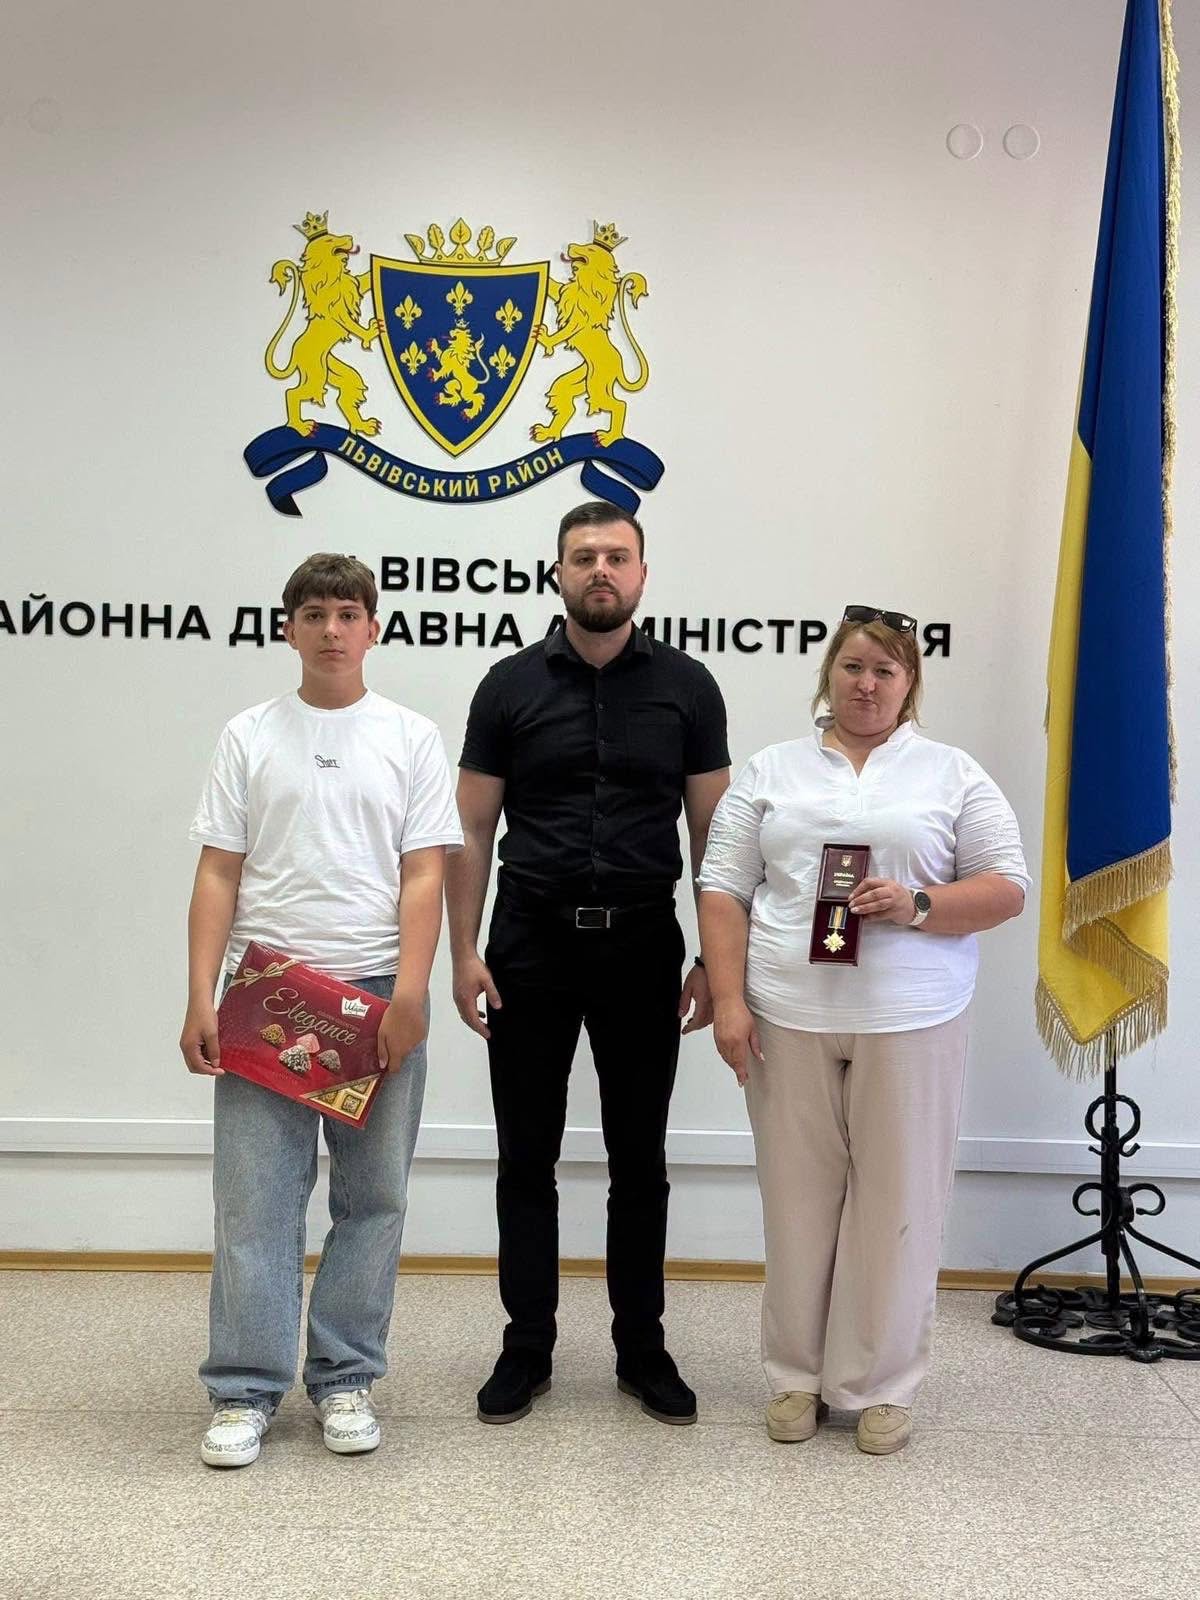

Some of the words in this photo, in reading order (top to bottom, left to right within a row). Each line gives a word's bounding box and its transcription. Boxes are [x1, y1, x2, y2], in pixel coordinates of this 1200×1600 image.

[338, 436, 479, 497] ЛЬВІВСЬКИЙ
[488, 447, 564, 494] РАЙОН
[349, 555, 561, 595] ВІВСЬК
[229, 606, 524, 648] ДЕАВНА
[544, 614, 951, 657] ІНІСТРЯ
[262, 987, 358, 1046] Elegance
